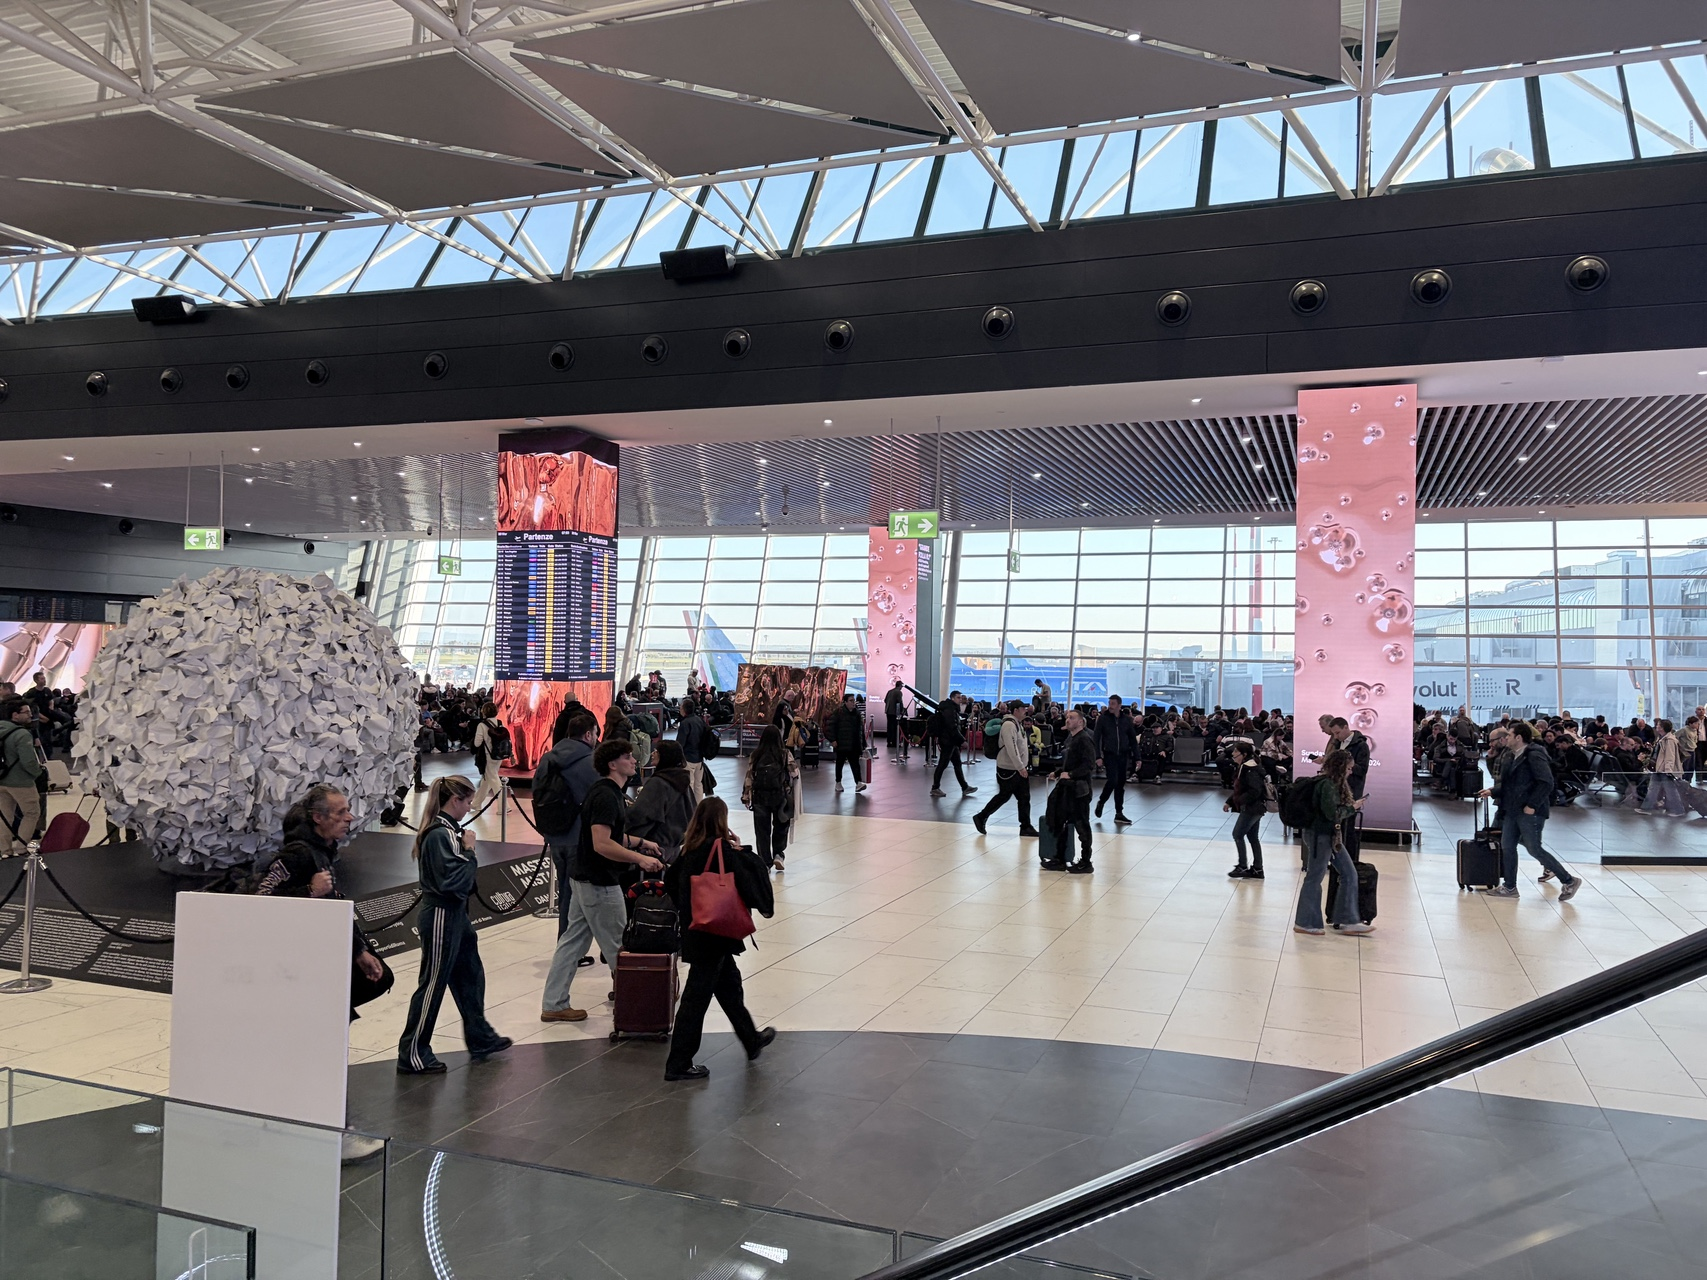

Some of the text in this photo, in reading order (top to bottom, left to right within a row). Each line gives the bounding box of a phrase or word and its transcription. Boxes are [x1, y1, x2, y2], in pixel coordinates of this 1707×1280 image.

[523, 533, 554, 541] Partenze
[1060, 680, 1107, 691] ITA
[1368, 759, 1381, 767] 024
